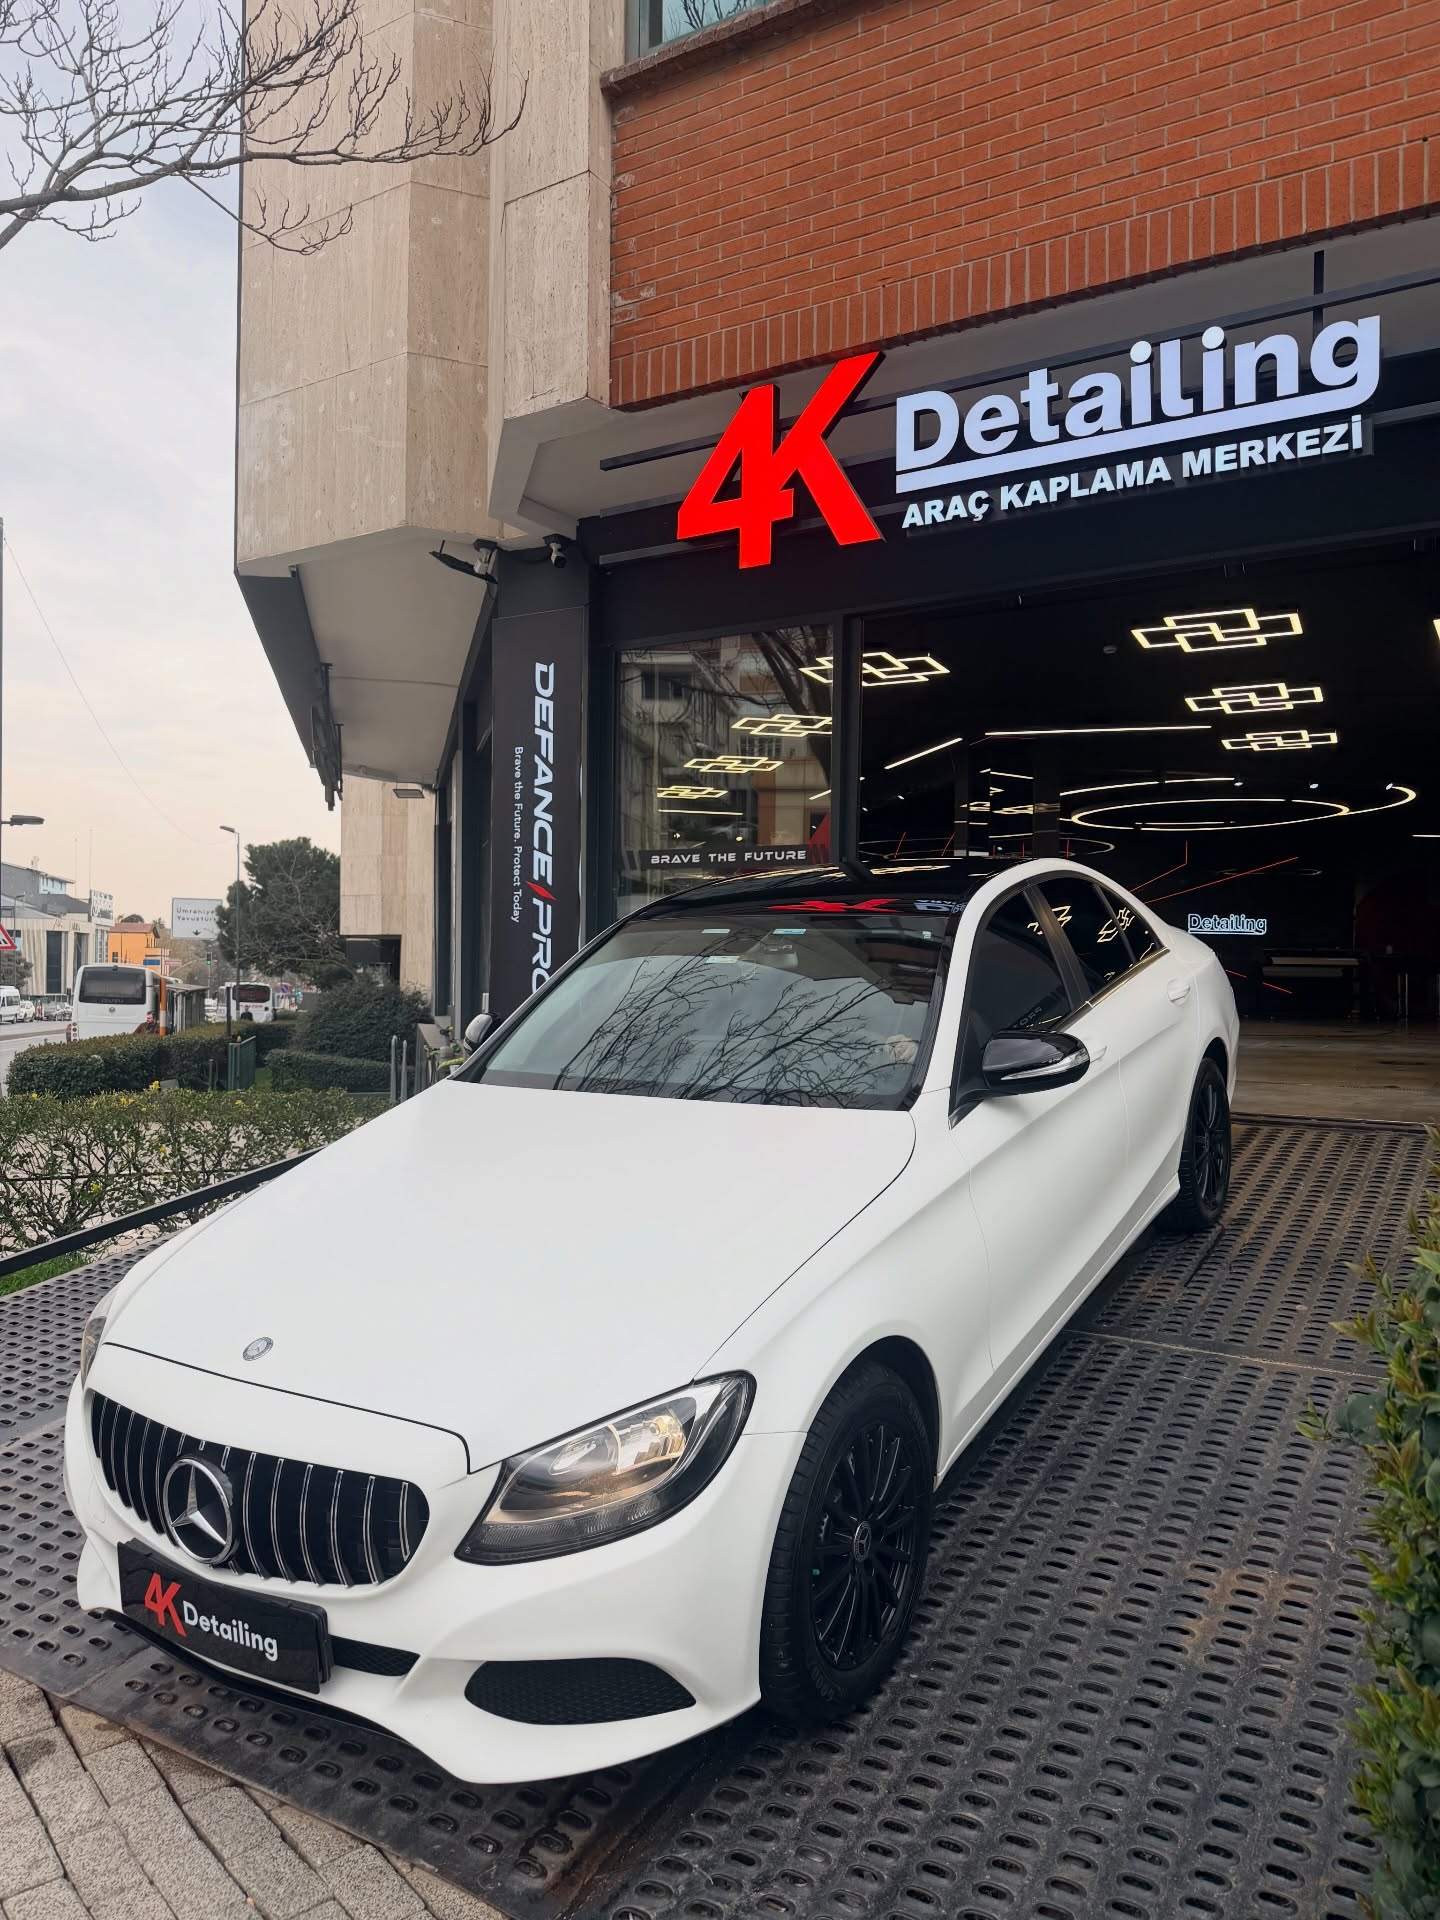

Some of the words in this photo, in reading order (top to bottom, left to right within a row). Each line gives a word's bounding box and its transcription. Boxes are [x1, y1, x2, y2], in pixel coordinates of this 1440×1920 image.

[676, 350, 884, 569] 4K
[896, 315, 1381, 473] Detailing
[901, 490, 990, 529] ARAÇ
[1000, 456, 1172, 510] KAPLAMA
[1182, 414, 1362, 478] MERKEZİ
[514, 746, 524, 779] Brave
[513, 781, 523, 800] the
[513, 803, 523, 843] Future.
[512, 846, 523, 887] Protect
[651, 854, 700, 864] BRAVE
[708, 852, 737, 862] THE
[744, 850, 807, 861] FUTURE
[511, 889, 522, 923] Today
[1188, 914, 1267, 935] Detailing
[144, 1572, 187, 1637] 4K
[183, 1600, 279, 1662] Detailing
